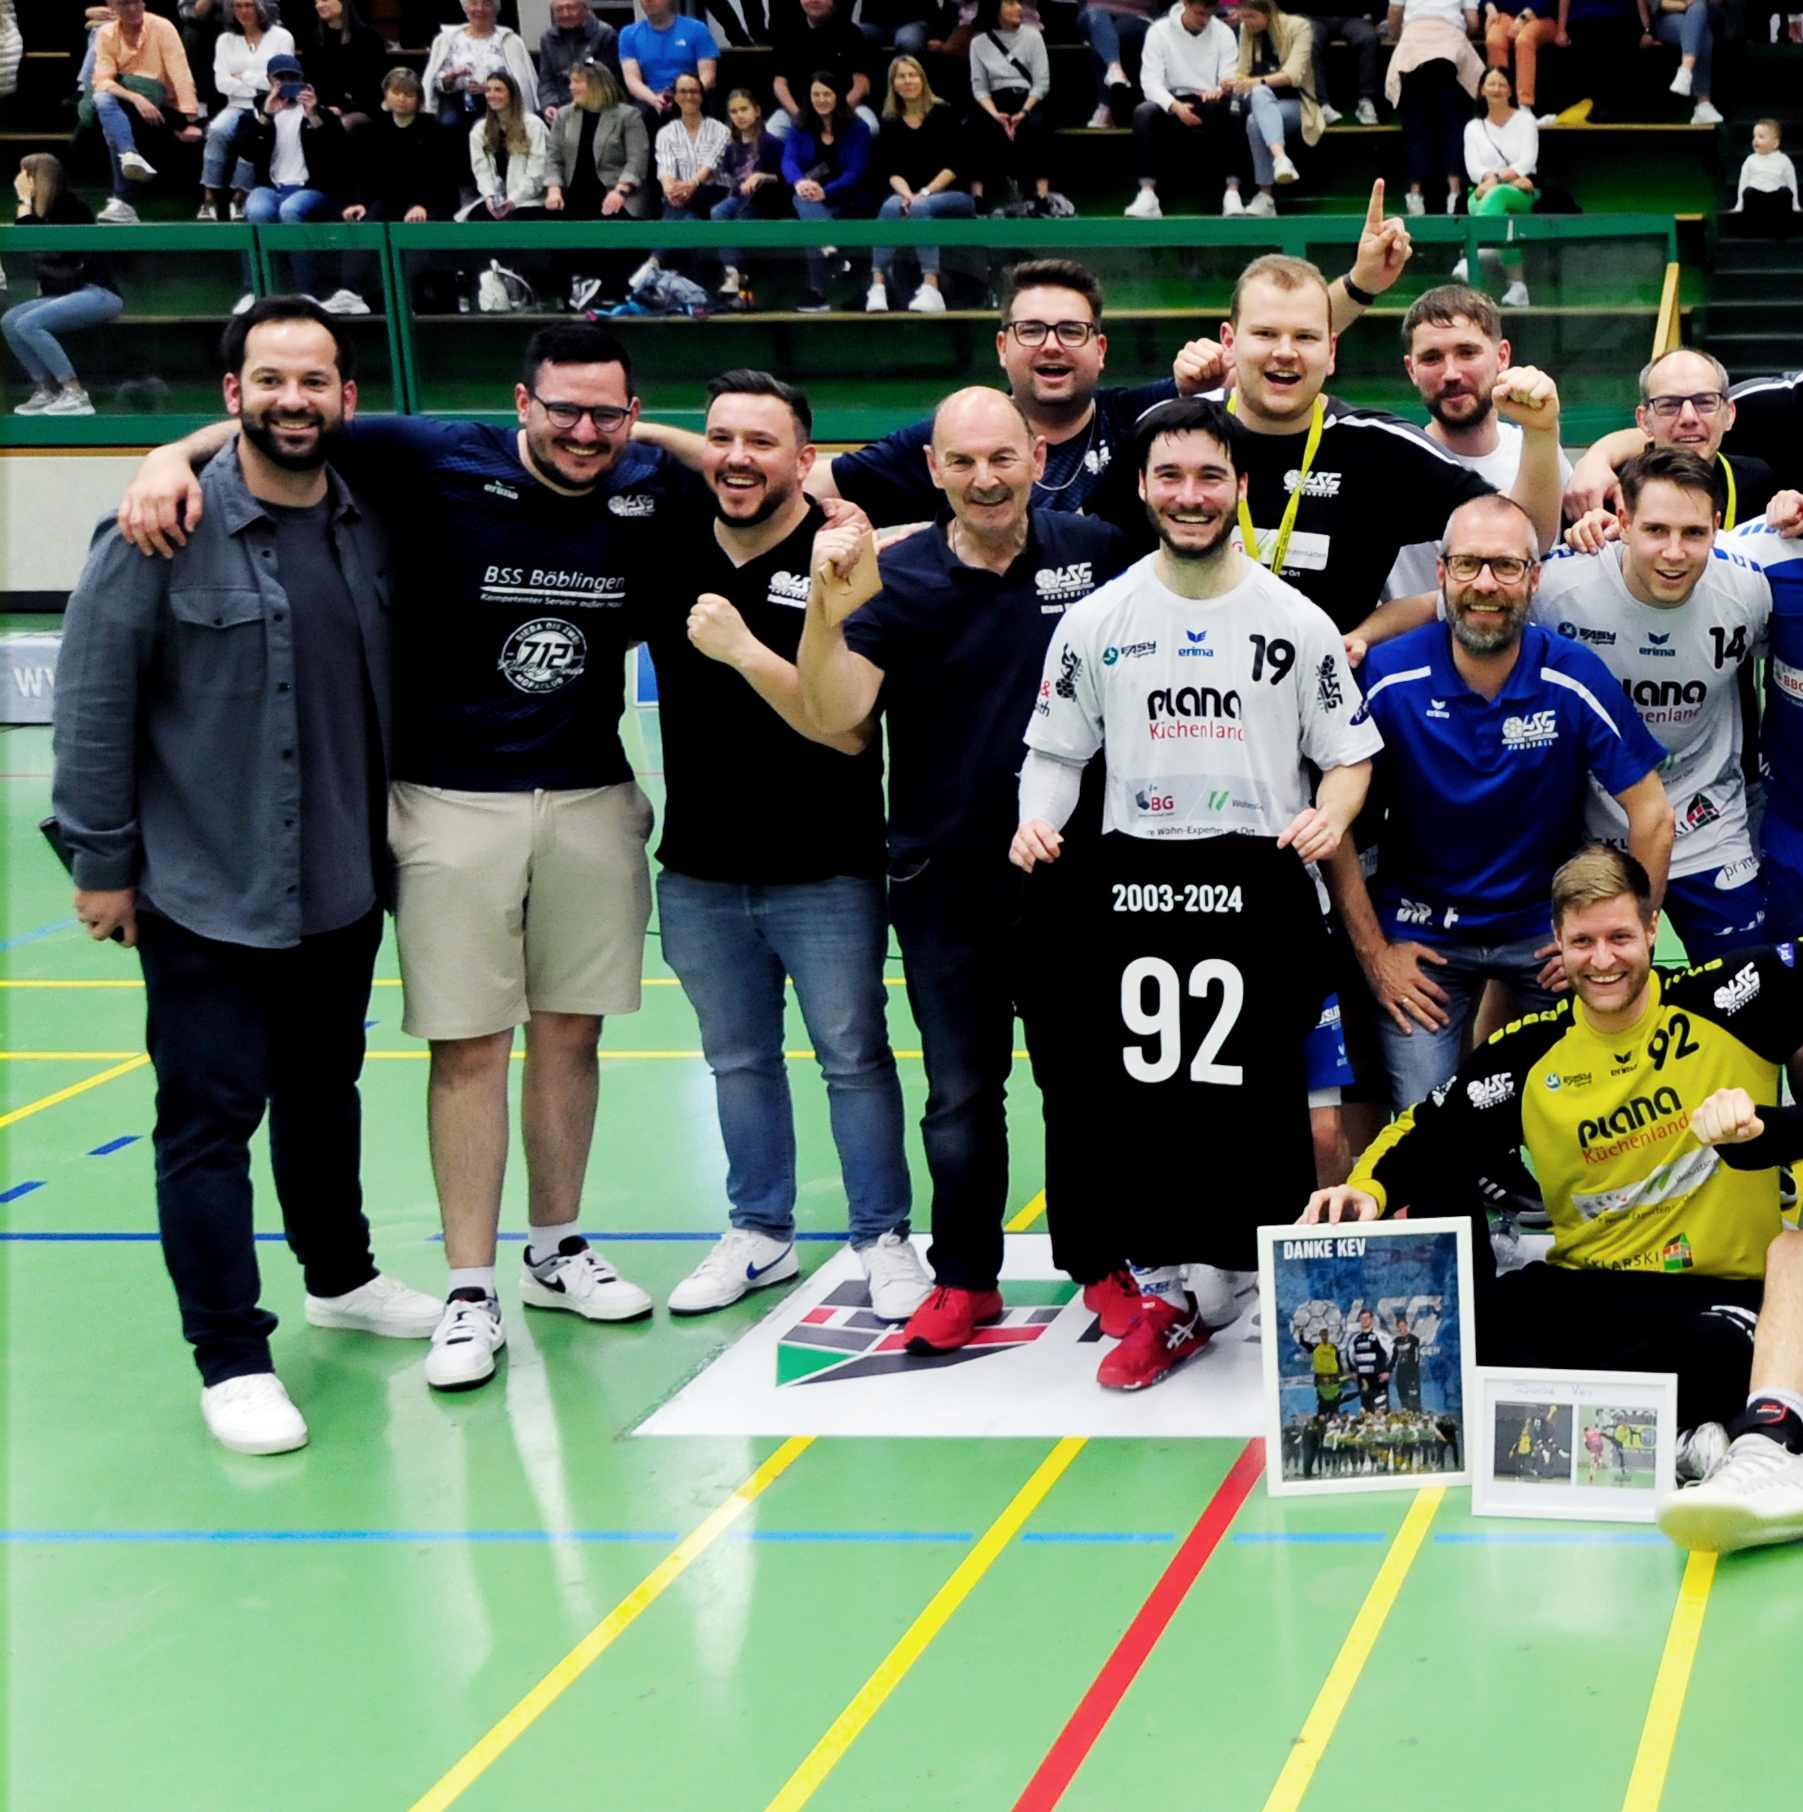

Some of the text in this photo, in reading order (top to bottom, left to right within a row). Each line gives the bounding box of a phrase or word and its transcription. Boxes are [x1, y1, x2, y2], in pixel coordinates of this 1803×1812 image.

[484, 566, 626, 593] BSS Böblingen
[518, 640, 573, 669] 712
[1178, 646, 1214, 657] erima
[1249, 633, 1295, 686] 19
[1639, 646, 1676, 657] erima
[1709, 625, 1747, 669] 14
[1621, 679, 1707, 708] lana
[1112, 884, 1243, 913] 2003-2024
[1121, 956, 1244, 1086] 92
[1647, 1013, 1699, 1071] 92
[1578, 1086, 1682, 1148] plana
[1582, 1111, 1690, 1164] Küchenland
[1283, 1238, 1366, 1260] DANKE KEV
